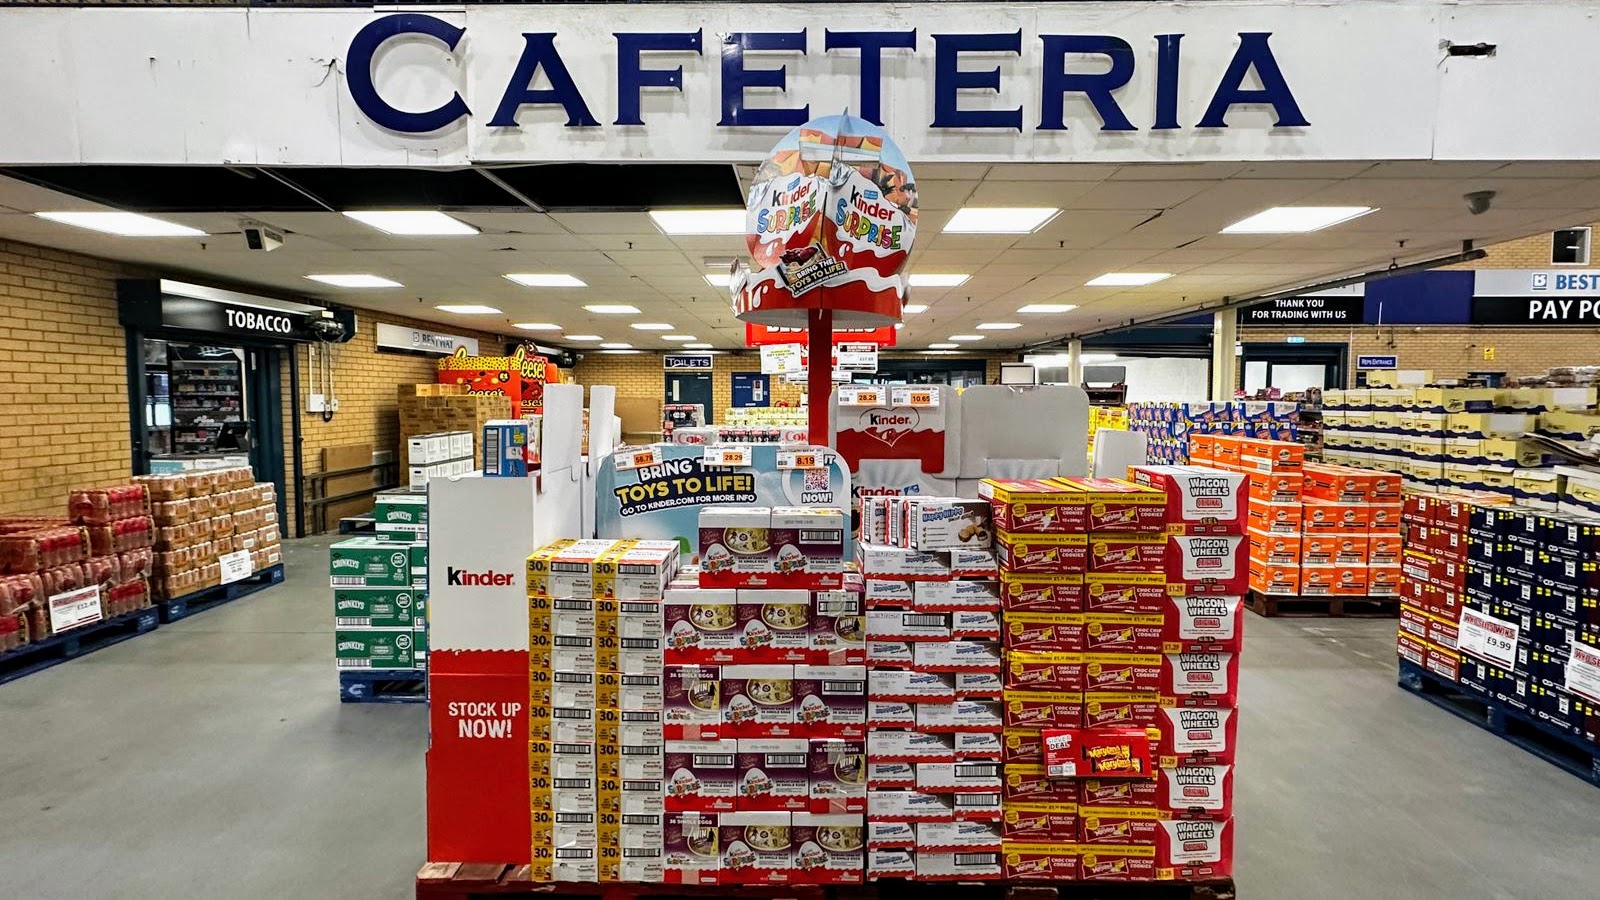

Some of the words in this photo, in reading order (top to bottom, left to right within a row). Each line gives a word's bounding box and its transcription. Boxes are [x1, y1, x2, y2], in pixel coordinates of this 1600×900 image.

[346, 13, 1311, 134] CAFETERIA
[757, 191, 818, 234] SURPRISE
[836, 198, 903, 250] SURPRISE
[797, 264, 818, 278] BRING
[819, 259, 834, 268] THE
[790, 276, 811, 291] TOYS
[811, 271, 823, 279] TO
[1275, 299, 1304, 308] THANK
[1306, 299, 1324, 308] YOU
[1529, 300, 1573, 319] PAY
[1252, 311, 1269, 319] FOR
[1271, 311, 1309, 319] TRADING
[225, 309, 291, 333] TOBACCO
[667, 358, 709, 368] TOILETS
[785, 430, 808, 443] Cok
[724, 454, 743, 462] 28.29
[796, 456, 815, 465] 8.19
[640, 459, 692, 482] BRING
[1190, 478, 1227, 489] WAGON
[617, 481, 668, 505] TOYS
[673, 477, 702, 495] TO
[706, 475, 752, 492] LIFE!
[1190, 487, 1229, 496] WHEELS
[622, 507, 634, 515] GO
[635, 504, 647, 512] TO
[647, 497, 694, 510] KINDER.COM
[695, 494, 711, 503] FOR
[712, 493, 735, 502] MORE
[736, 493, 755, 501] INFO
[1190, 539, 1227, 548] WAGON
[1191, 548, 1229, 557] WHEELS
[1187, 597, 1224, 607] WAGON
[1188, 606, 1227, 616] WHEELS
[1487, 636, 1511, 651] £9.99
[1180, 653, 1219, 663] WAGON
[1181, 661, 1220, 671] WHEELS
[448, 702, 497, 717] STOCK
[501, 702, 521, 716] UP
[1180, 711, 1216, 720] WAGON
[458, 719, 512, 738] NOW!
[1181, 720, 1218, 729] WHEELS
[1089, 746, 1121, 758] Maryland
[1098, 759, 1131, 771] Maryland
[1176, 767, 1213, 777] WAGON
[1177, 775, 1214, 784] WHEELS
[1177, 823, 1213, 832] WAGON
[1178, 831, 1213, 840] WHEELS
